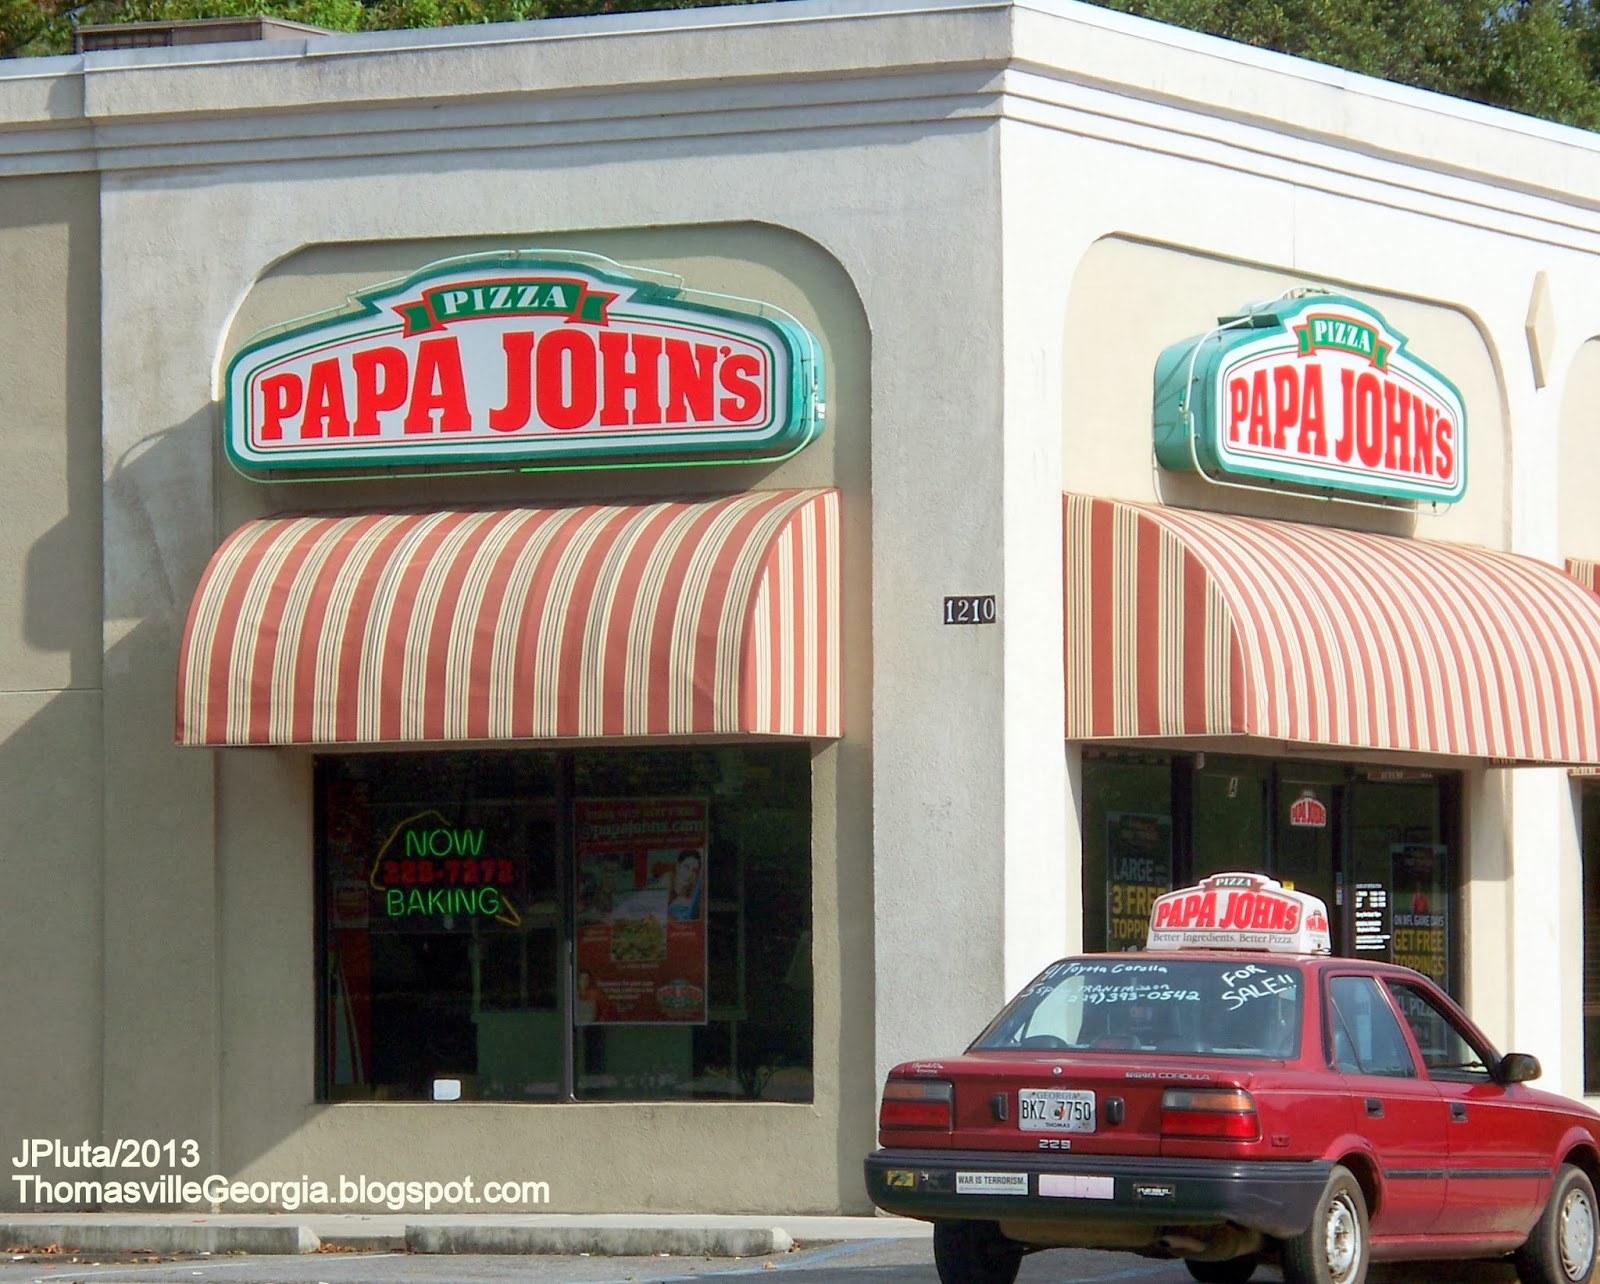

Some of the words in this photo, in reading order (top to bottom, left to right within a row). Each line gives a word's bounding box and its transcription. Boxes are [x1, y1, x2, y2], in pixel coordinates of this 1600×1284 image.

[442, 285, 568, 315] PIZZA
[1314, 319, 1371, 353] PIZZA
[261, 336, 472, 440] PAPA
[489, 329, 762, 432] JOHN'S
[1230, 364, 1327, 457] PAPA
[1335, 368, 1453, 479] JOHN'S
[946, 598, 995, 622] 1210
[406, 828, 484, 857] NOW
[1113, 857, 1153, 881] LARGE
[1216, 877, 1252, 887] PIZZA
[386, 887, 500, 916] BAKING
[1112, 885, 1122, 915] 3
[1127, 885, 1167, 915] FRE
[1155, 892, 1217, 927] PAPA
[1153, 933, 1180, 942] Better
[1240, 934, 1267, 943] Better
[1394, 929, 1415, 951] GET
[1417, 930, 1444, 951] FREE
[1062, 963, 1107, 976] Toyota
[1111, 964, 1168, 973] Corolla
[1221, 964, 1268, 987] FOR
[1036, 1091, 1080, 1100] GEORGIA
[1022, 1100, 1047, 1120] BKZ
[1056, 1101, 1092, 1121] 7750
[958, 1176, 974, 1184] WAR
[975, 1176, 983, 1184] IS
